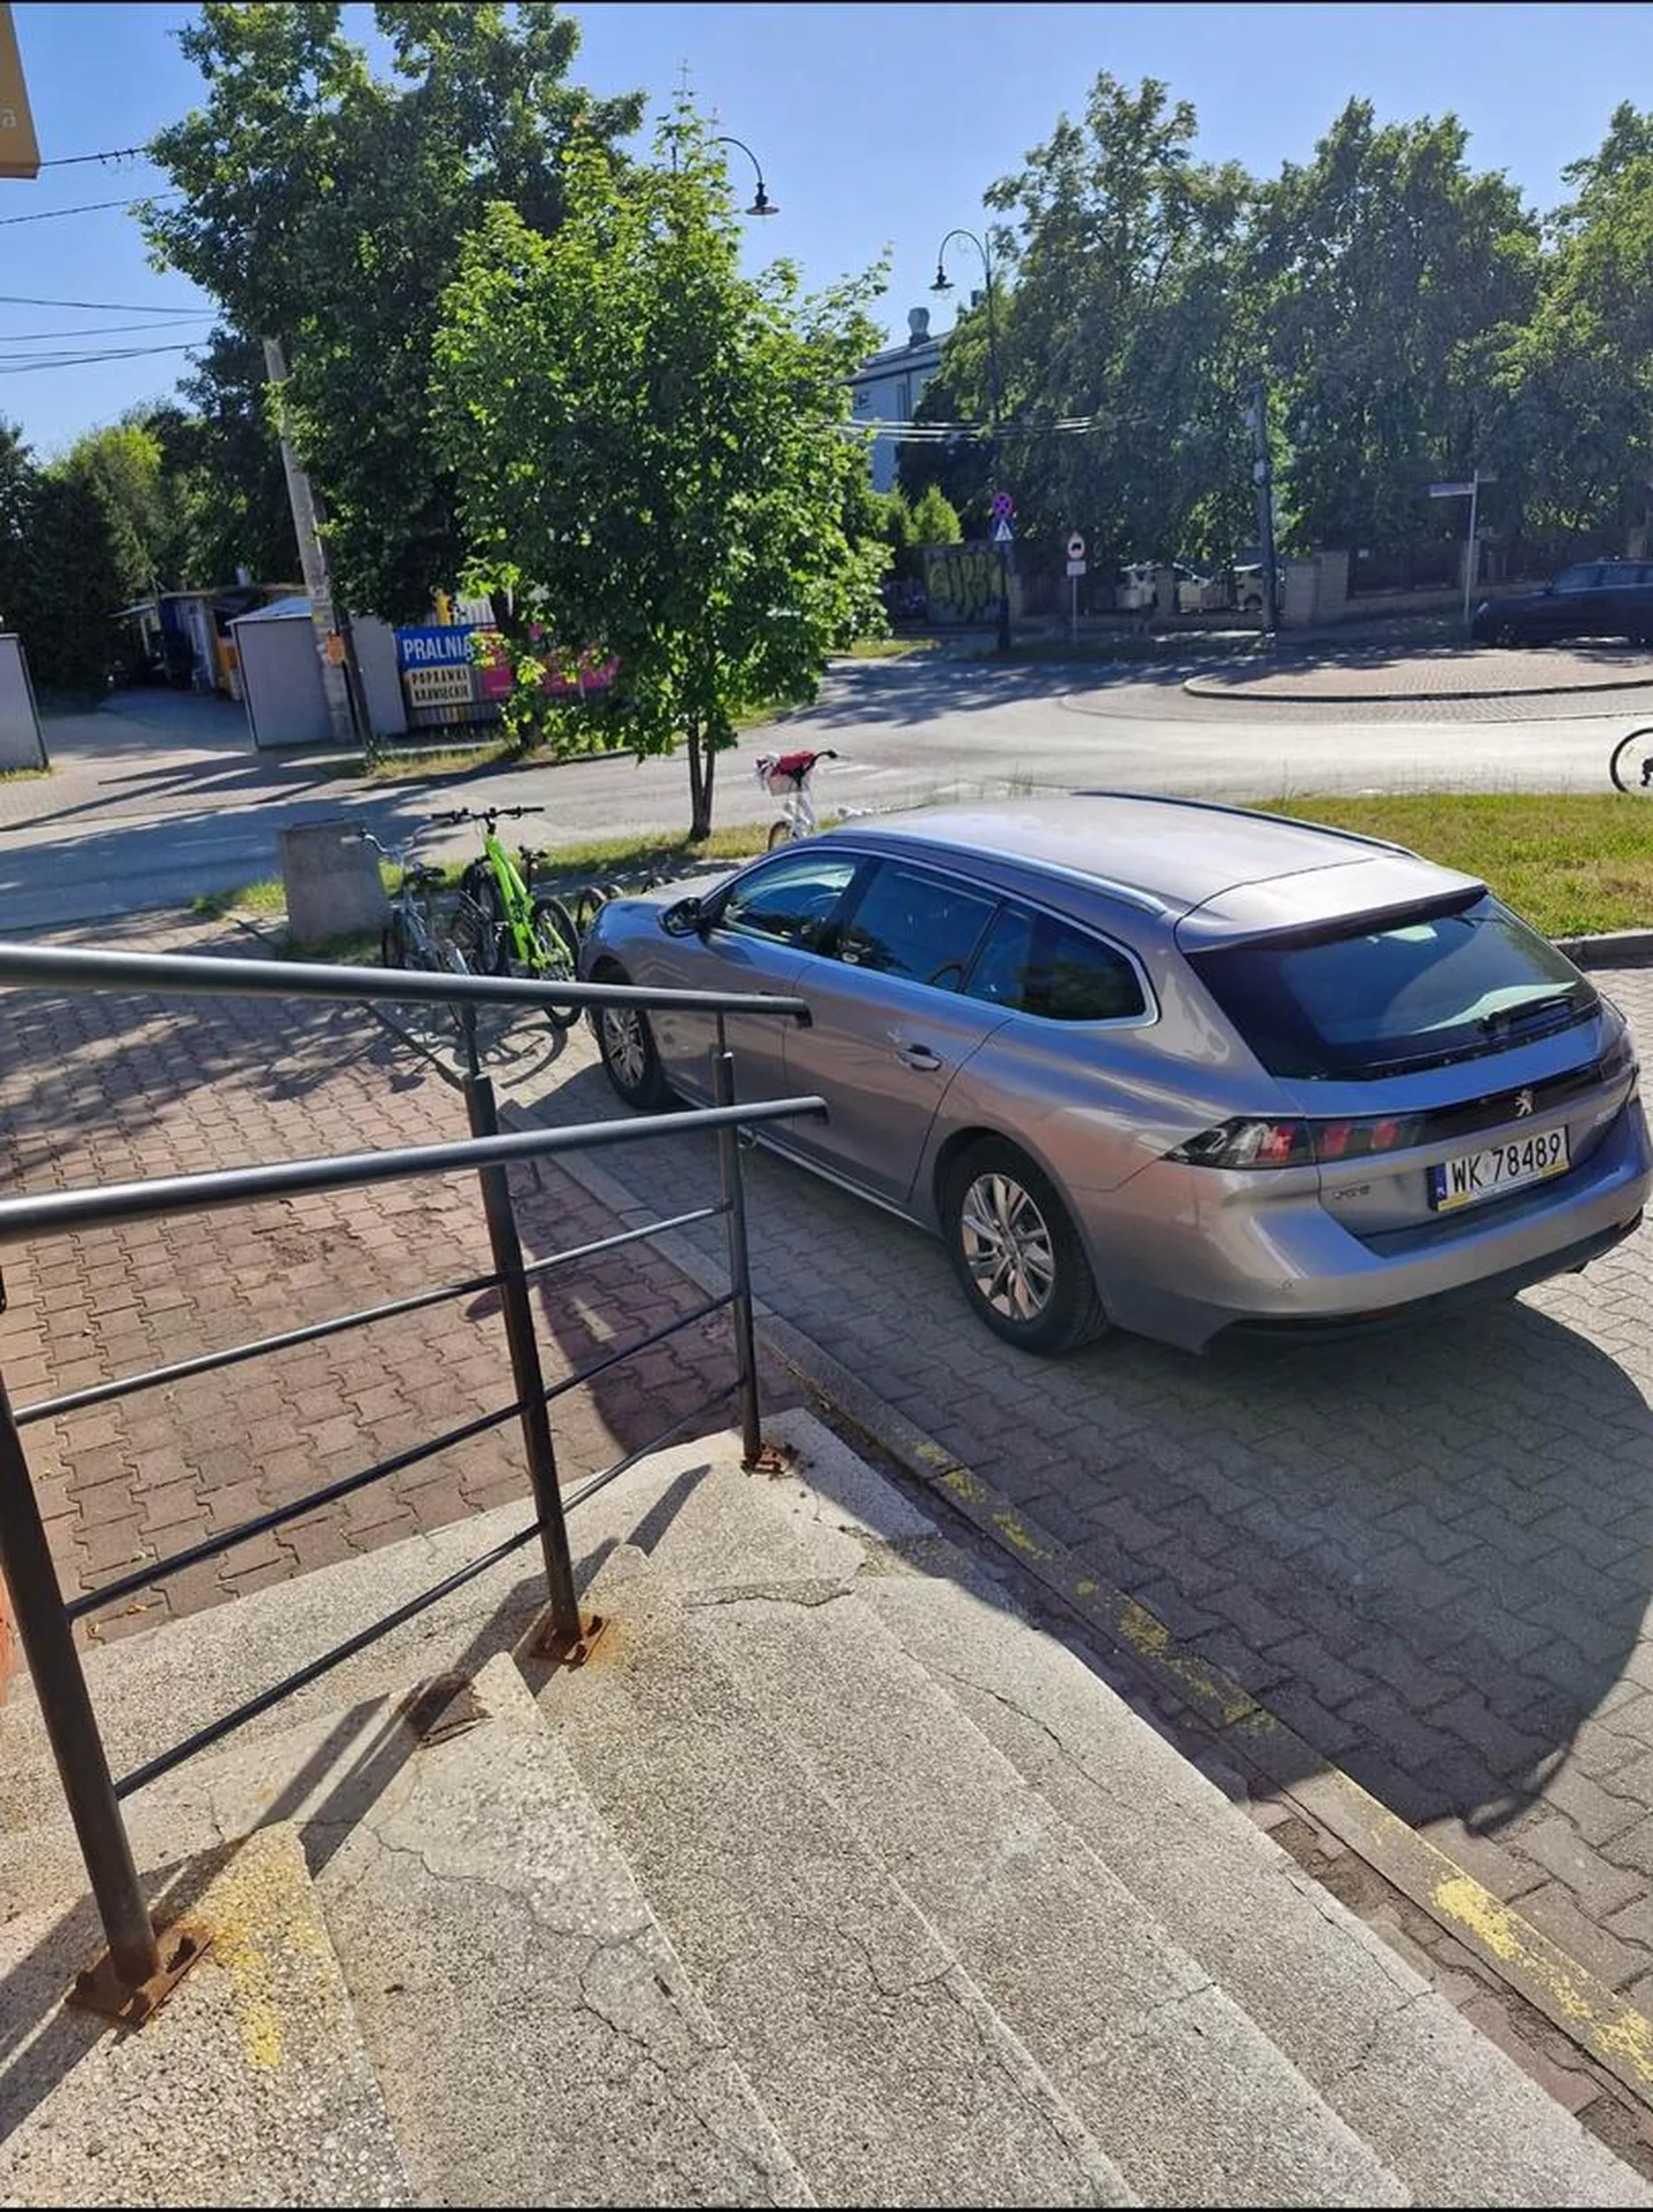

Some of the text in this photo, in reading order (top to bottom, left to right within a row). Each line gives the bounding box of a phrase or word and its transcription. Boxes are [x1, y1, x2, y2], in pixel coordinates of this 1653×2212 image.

[403, 635, 473, 662] PRALNIA
[411, 670, 468, 685] POPRAWKI
[1451, 1155, 1483, 1192] WK
[1491, 1133, 1561, 1181] 78489
